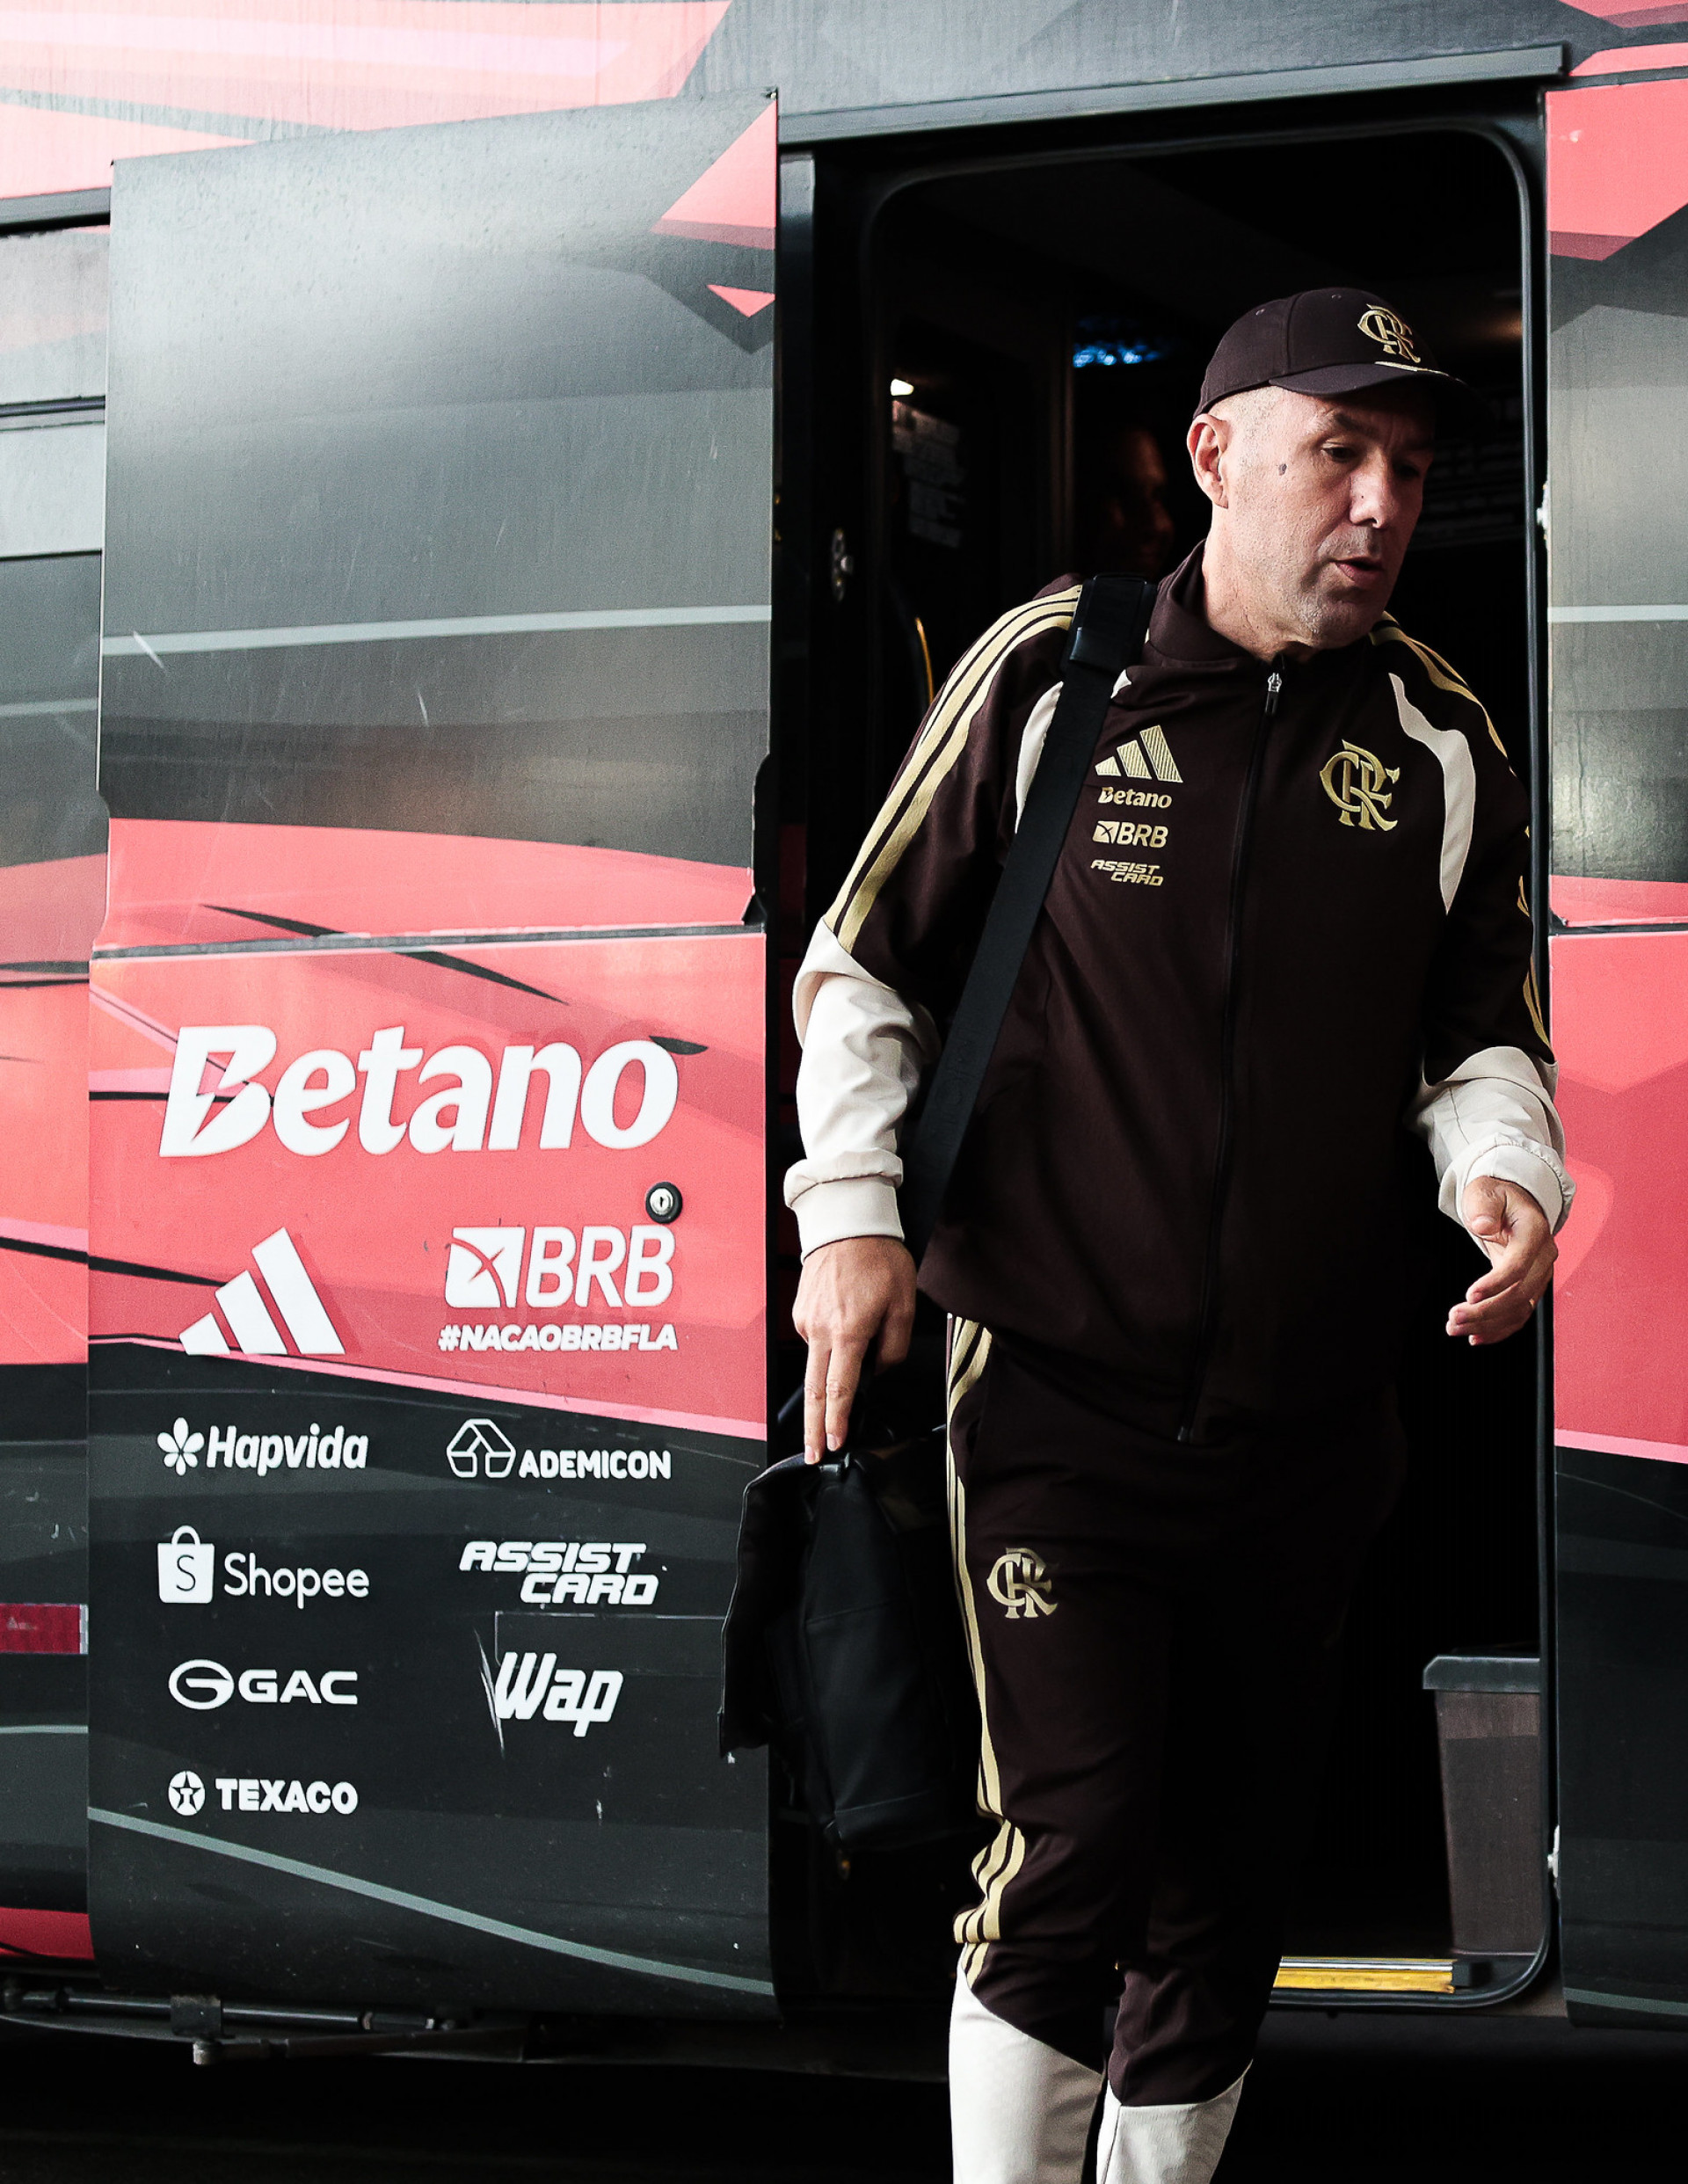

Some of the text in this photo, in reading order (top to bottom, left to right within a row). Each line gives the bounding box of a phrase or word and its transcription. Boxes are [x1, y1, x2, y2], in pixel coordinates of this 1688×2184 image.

[1097, 786, 1173, 809] Betano
[1117, 821, 1169, 848] BRB
[1090, 859, 1160, 874] ASSIST
[1110, 871, 1164, 887] CARD
[159, 1025, 679, 1157] Betano
[526, 1226, 676, 1308] BRB
[207, 1423, 368, 1477] Hapvida
[518, 1450, 672, 1480] ADEMICON
[460, 1542, 646, 1572] ASSIST
[223, 1552, 370, 1610] Shopee
[520, 1573, 659, 1605] CARD
[238, 1669, 358, 1705] GAC
[494, 1651, 623, 1738] Wap
[215, 1778, 359, 1815] TEXACO
